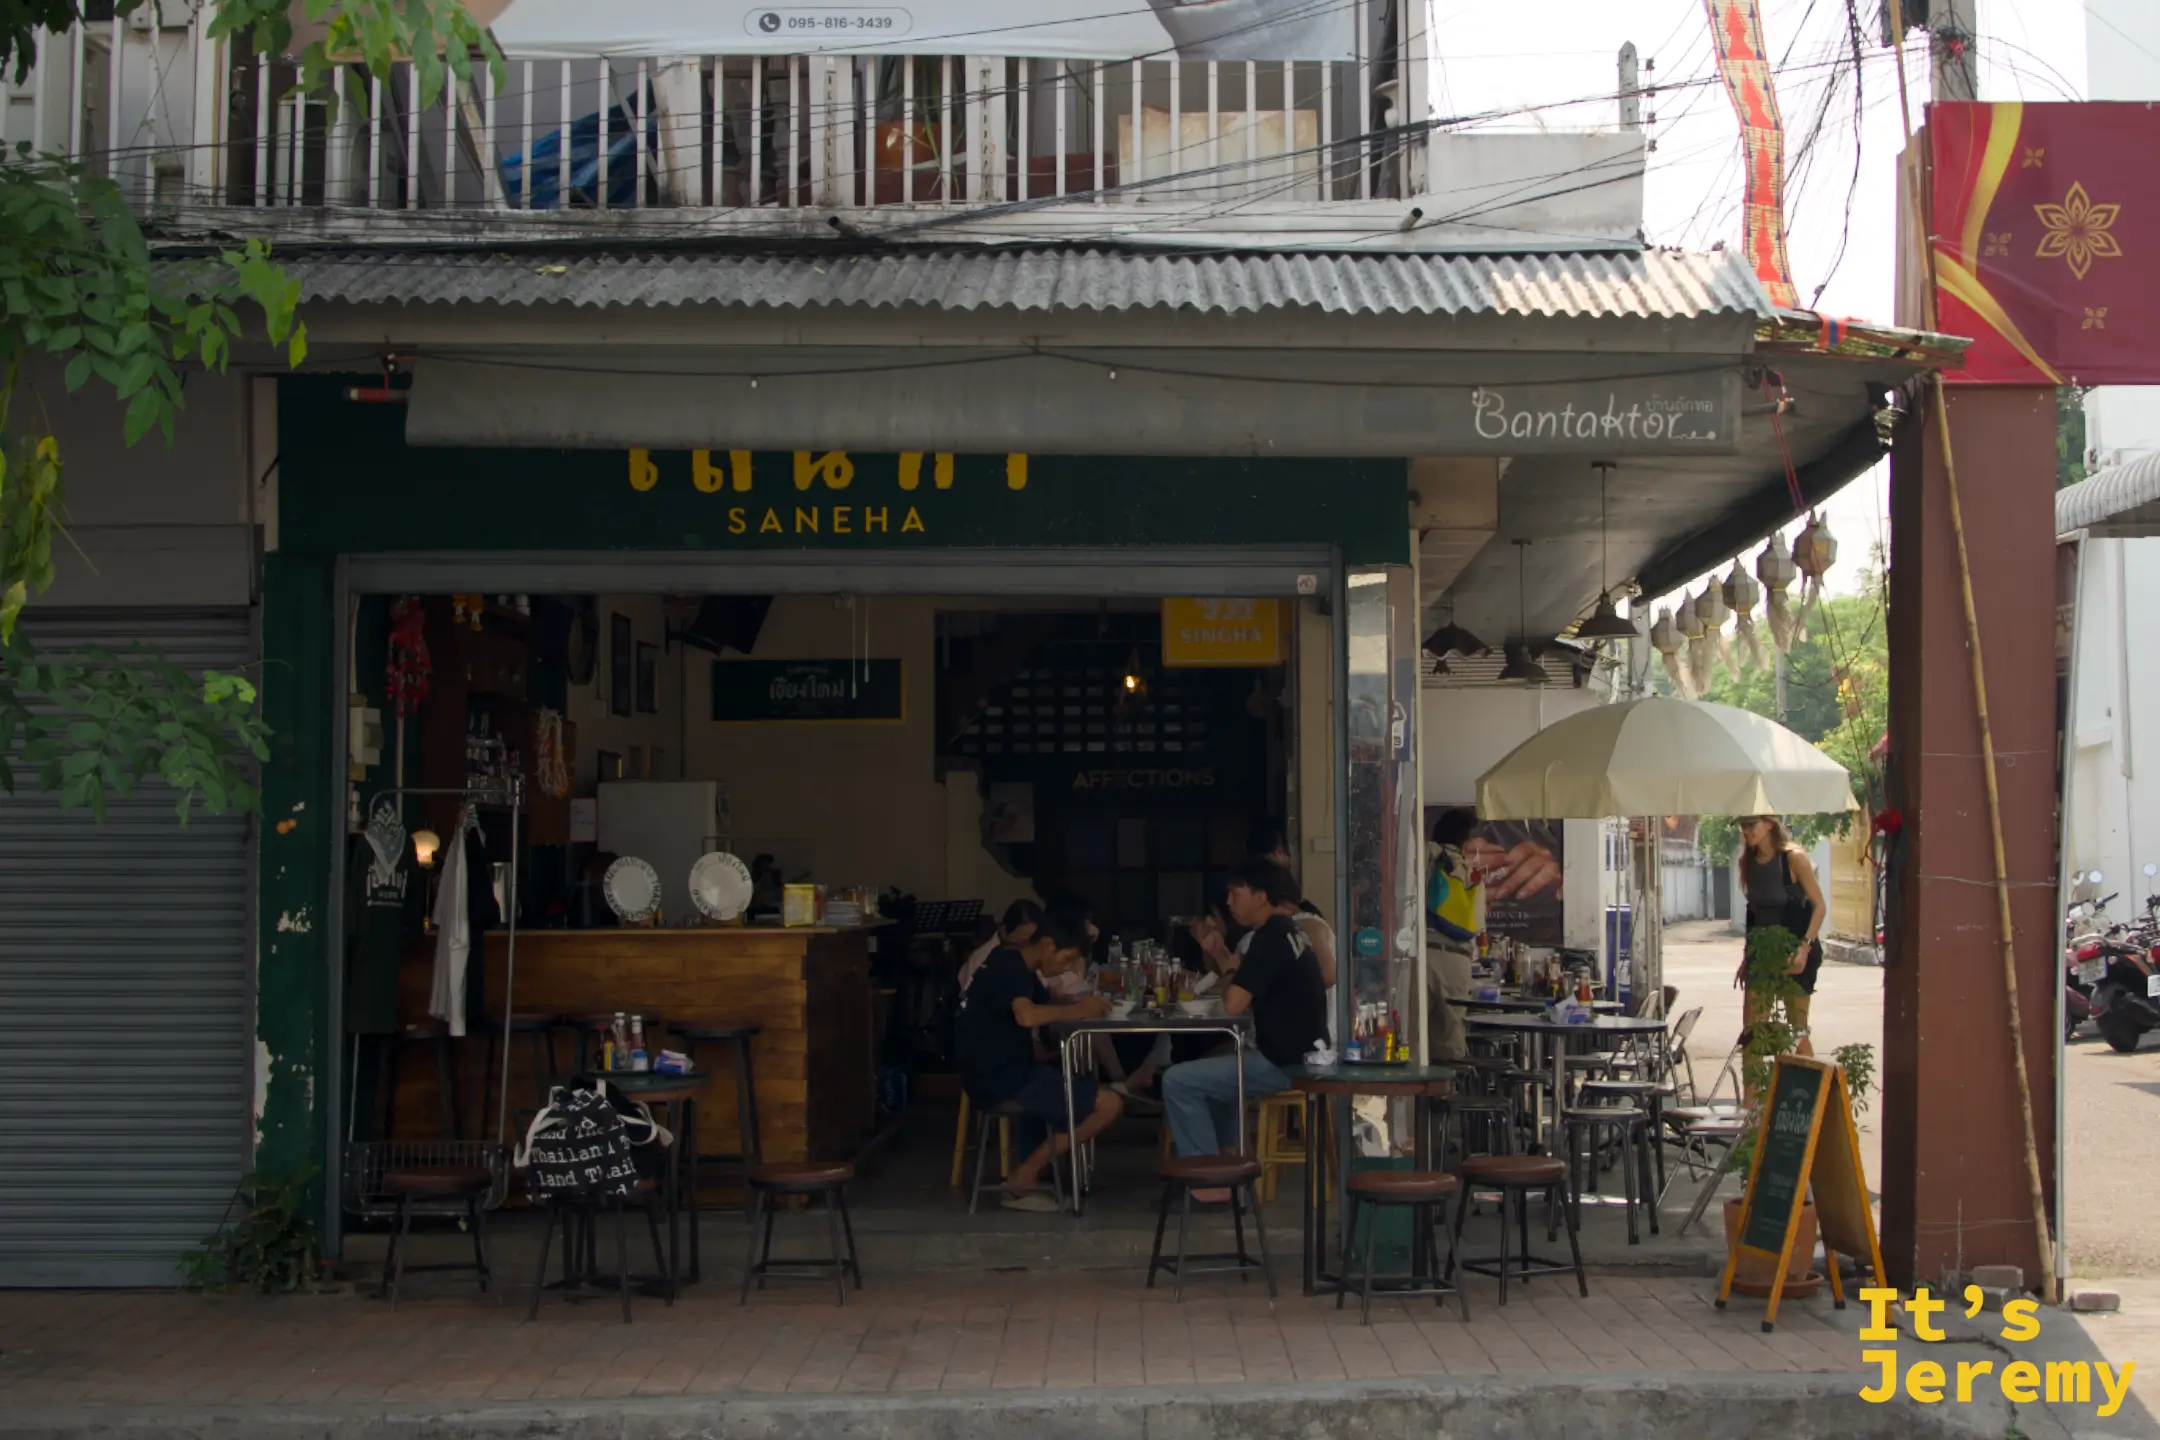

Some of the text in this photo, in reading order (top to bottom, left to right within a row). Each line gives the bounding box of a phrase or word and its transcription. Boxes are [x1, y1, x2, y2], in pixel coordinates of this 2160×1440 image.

[788, 17, 893, 29] 095-816-3439
[727, 505, 926, 534] SANEHA
[1180, 625, 1263, 644] SINGHA
[1073, 767, 1216, 789] AFFECTIONS
